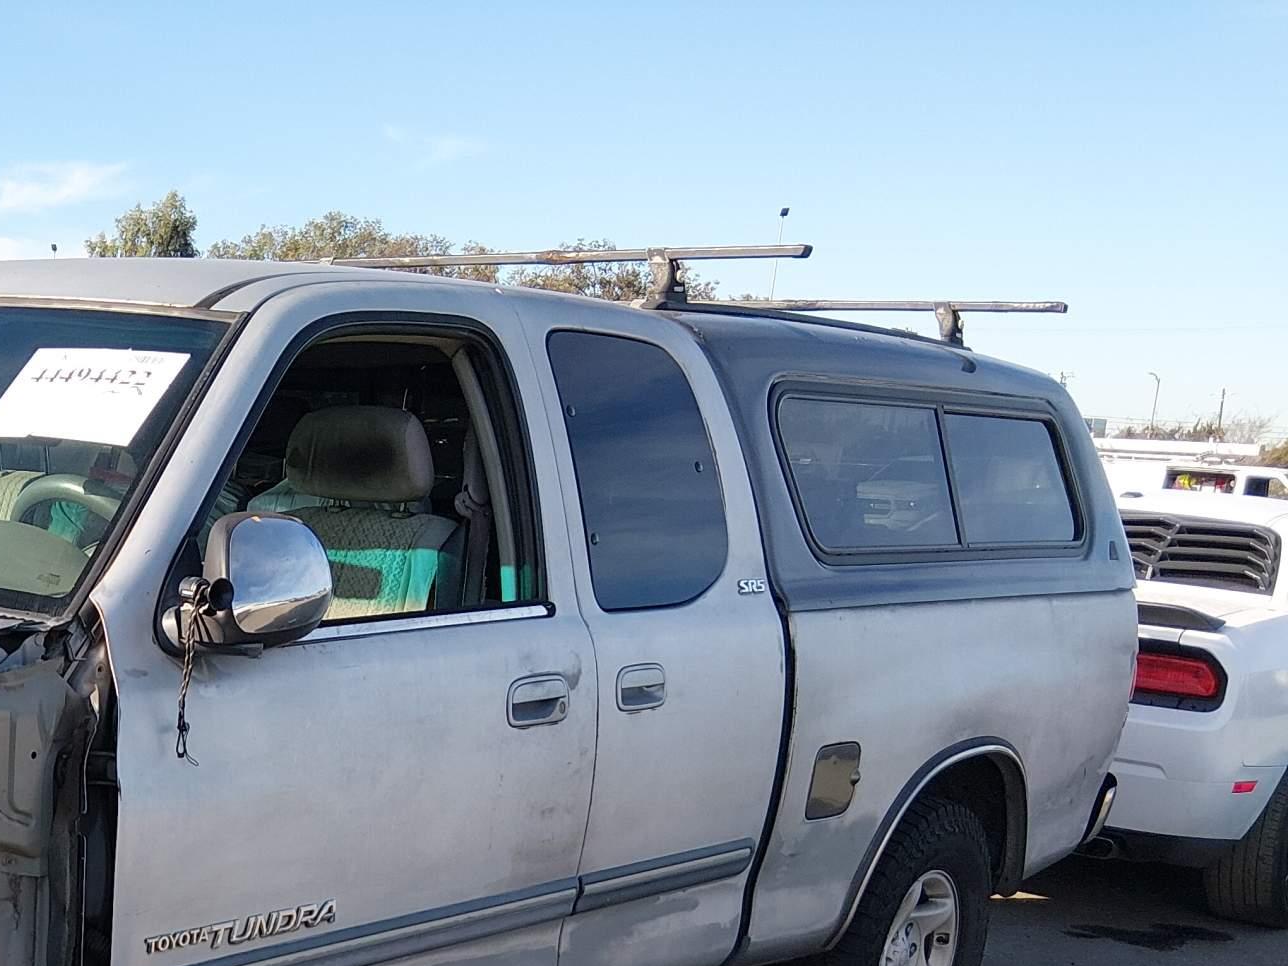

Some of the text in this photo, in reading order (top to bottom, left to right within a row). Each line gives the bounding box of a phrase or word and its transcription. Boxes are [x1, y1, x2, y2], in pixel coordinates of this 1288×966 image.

[738, 579, 765, 594] SR5
[144, 898, 337, 954] TOYOTA TUNDRA
